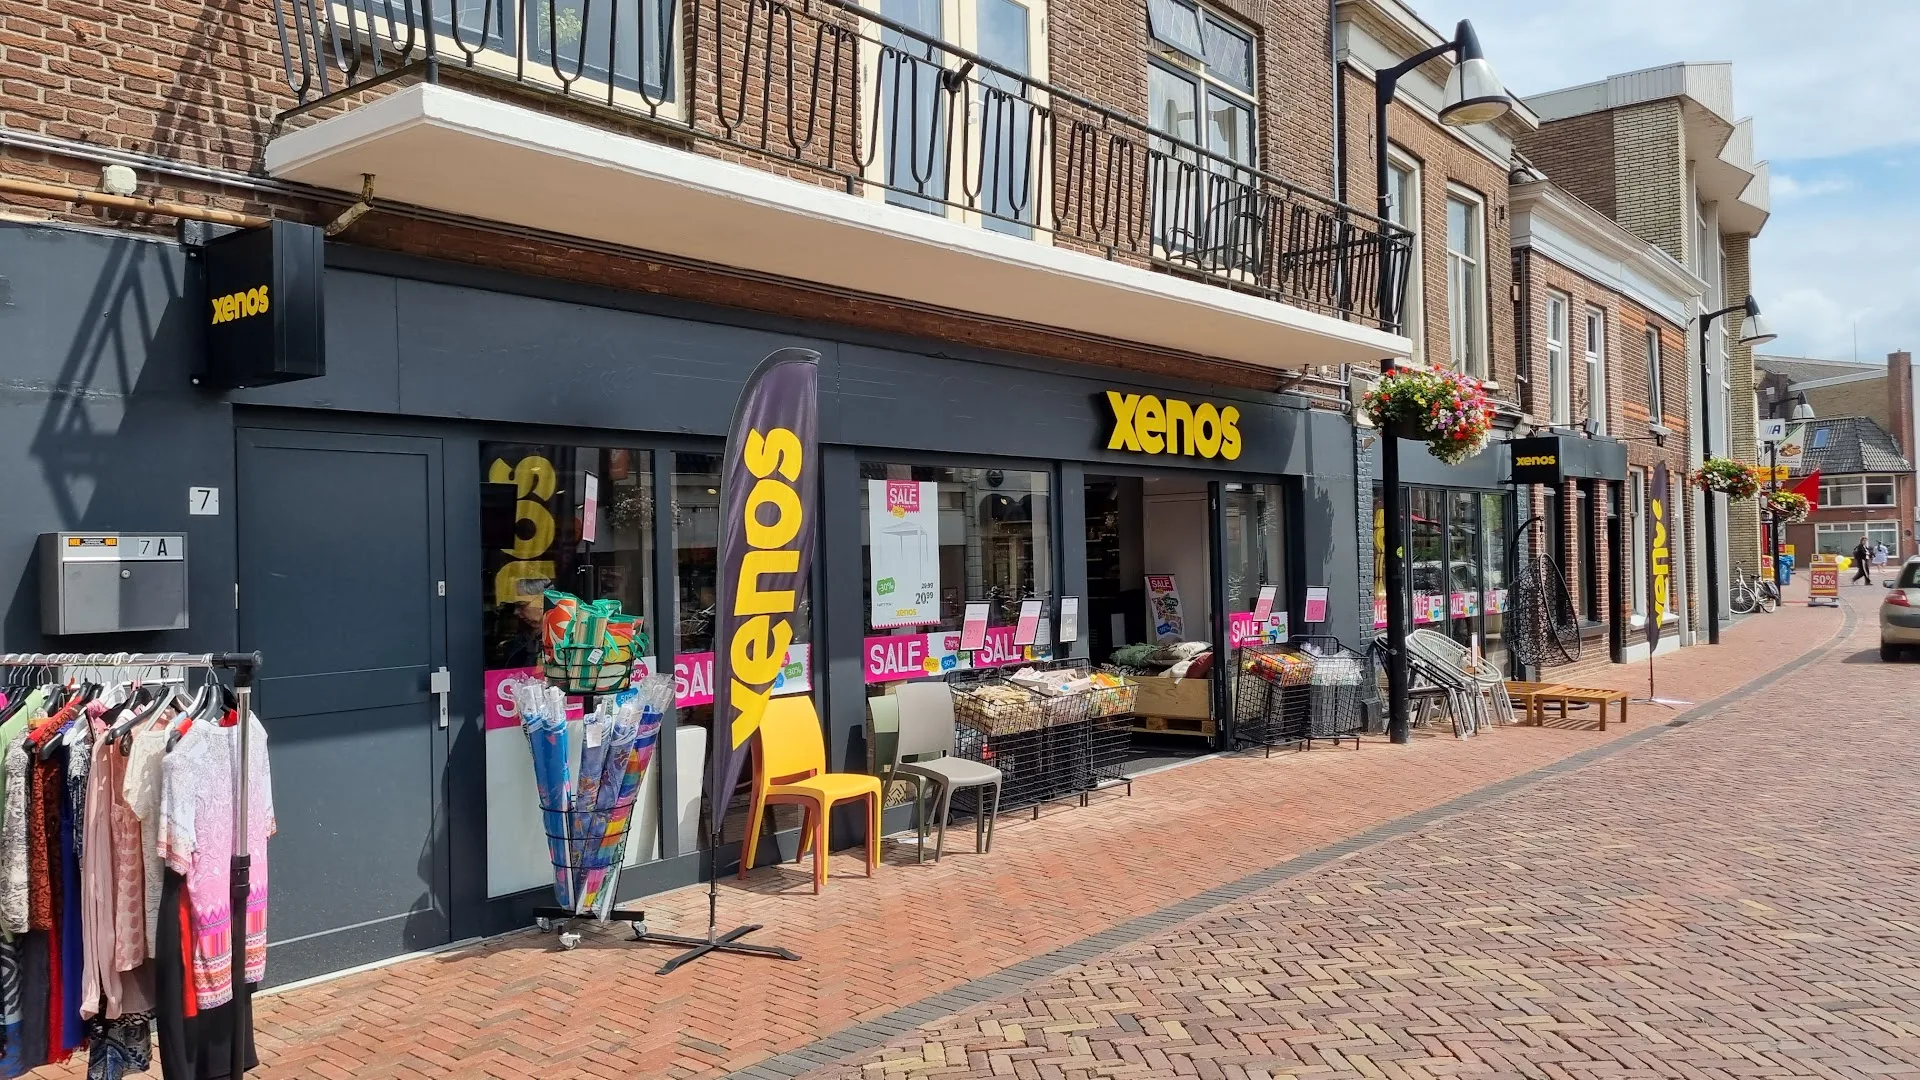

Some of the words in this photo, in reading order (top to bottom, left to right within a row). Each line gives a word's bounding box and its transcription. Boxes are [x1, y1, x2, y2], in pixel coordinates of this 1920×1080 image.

[211, 285, 269, 325] xenos
[1106, 390, 1242, 461] xenos
[1515, 455, 1556, 466] xenos
[197, 489, 211, 511] 7
[889, 487, 917, 505] SALE
[140, 540, 151, 555] 7
[157, 538, 168, 556] A
[730, 427, 803, 751] xenos
[1151, 579, 1171, 588] SALE
[1812, 574, 1836, 585] 50%
[1232, 620, 1260, 642] SALE
[869, 640, 922, 675] SALE
[674, 660, 714, 699] SAL
[785, 666, 802, 677] -30%
